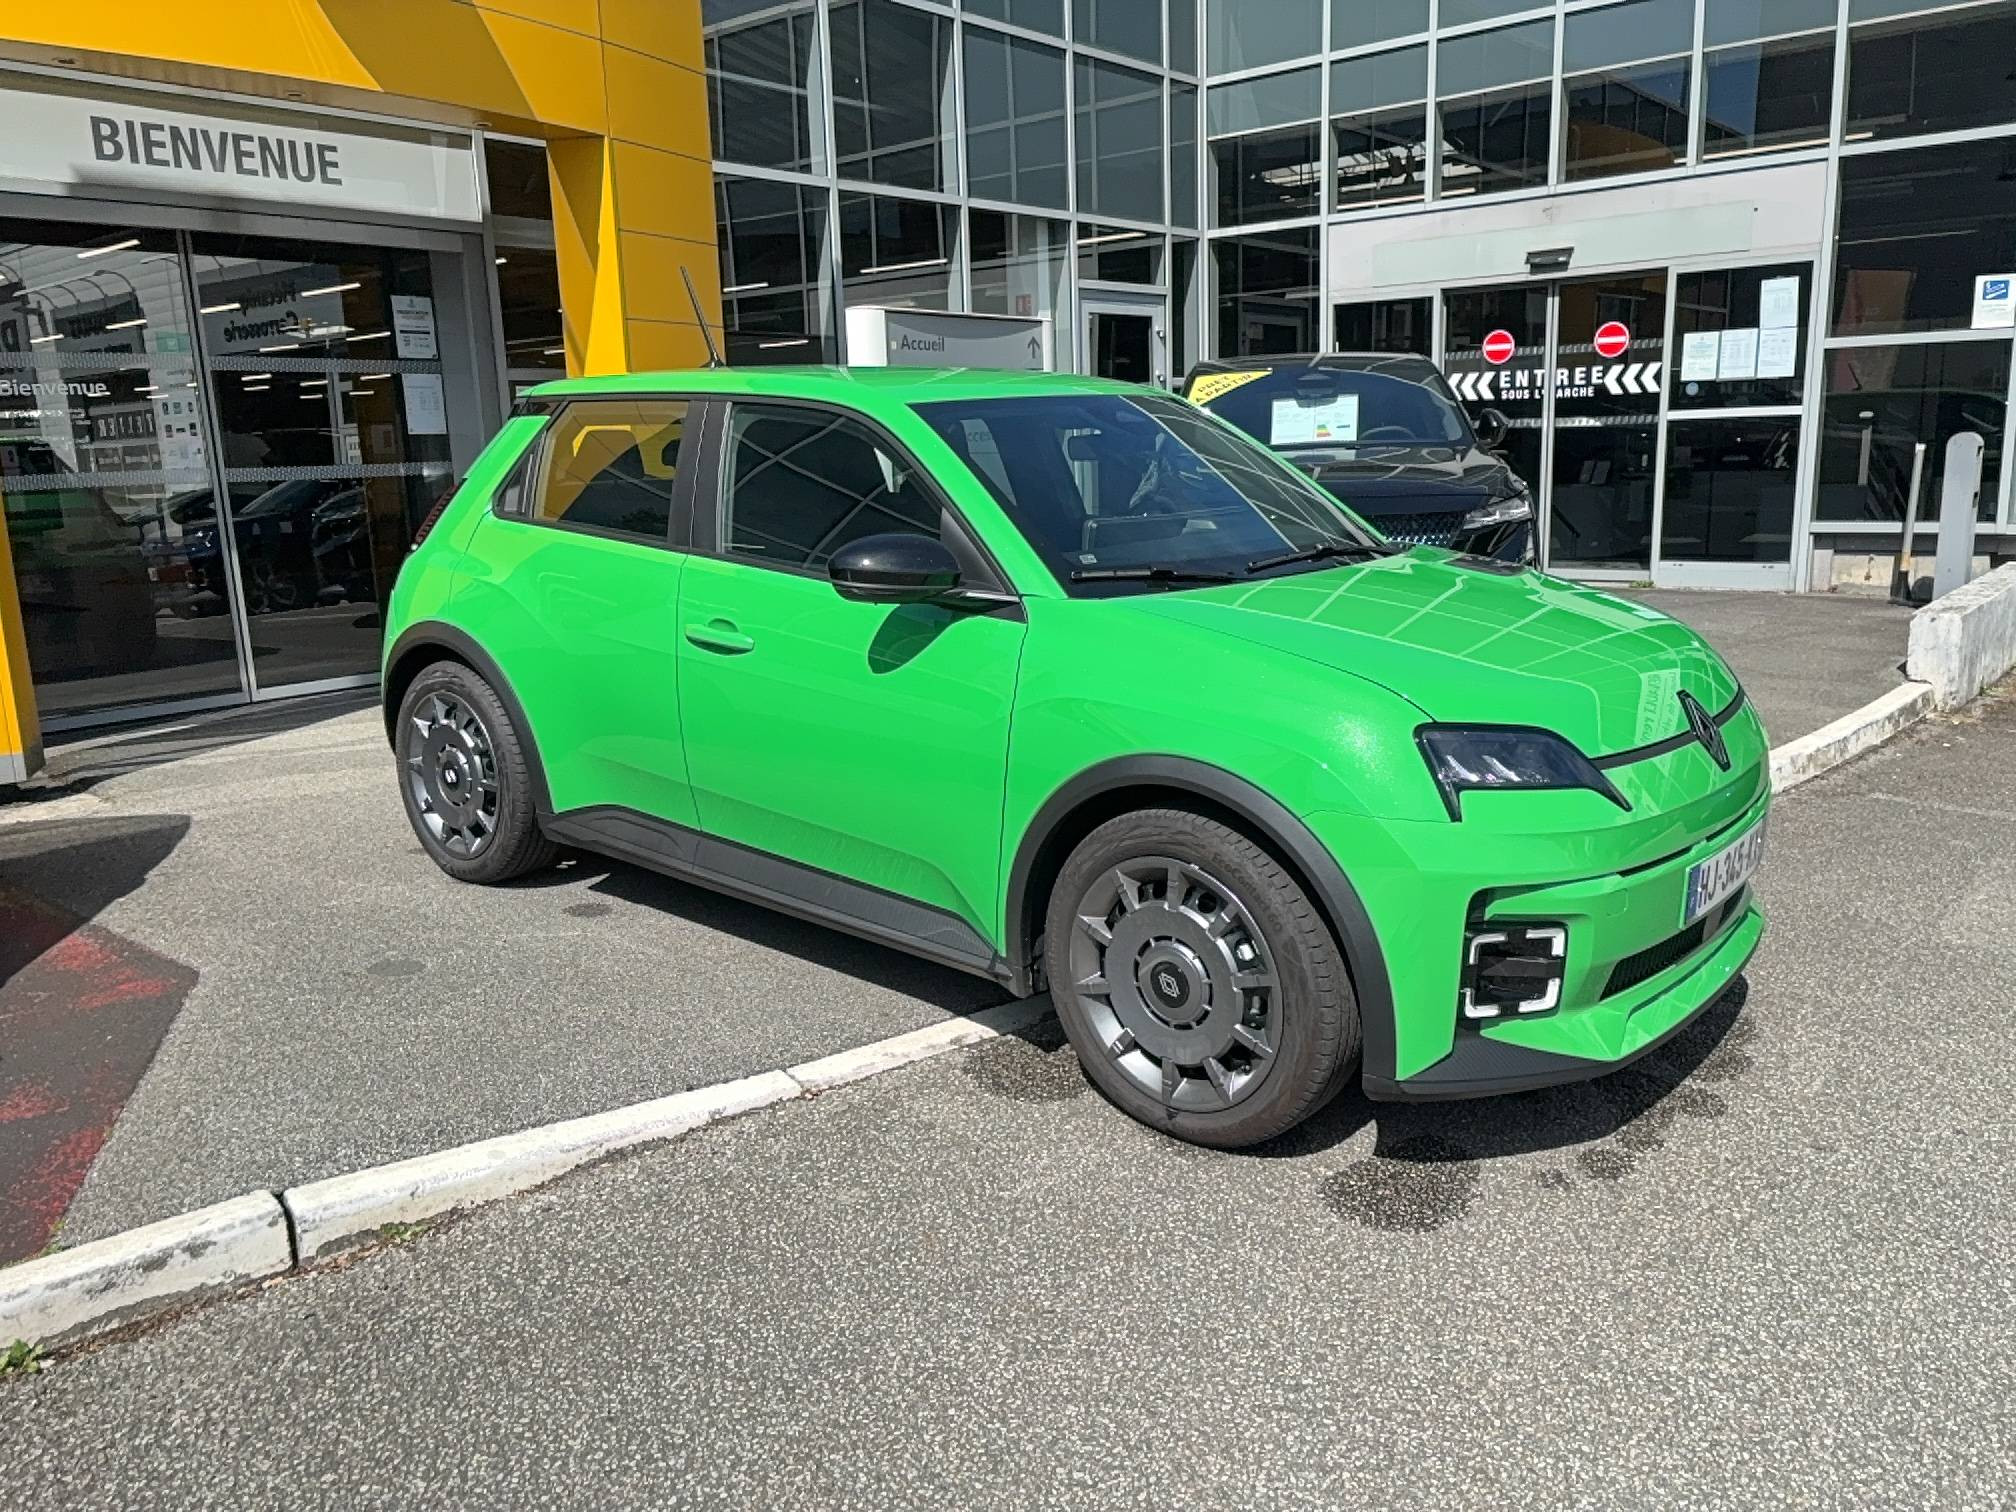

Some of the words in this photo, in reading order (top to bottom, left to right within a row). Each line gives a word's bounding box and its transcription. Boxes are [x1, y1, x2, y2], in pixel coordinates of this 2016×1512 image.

[90, 115, 342, 186] BIENVENUE
[901, 334, 945, 352] Accueil
[1500, 365, 1603, 388] ENTREE
[0, 379, 107, 396] Bienvenue
[1501, 388, 1530, 400] SOUS
